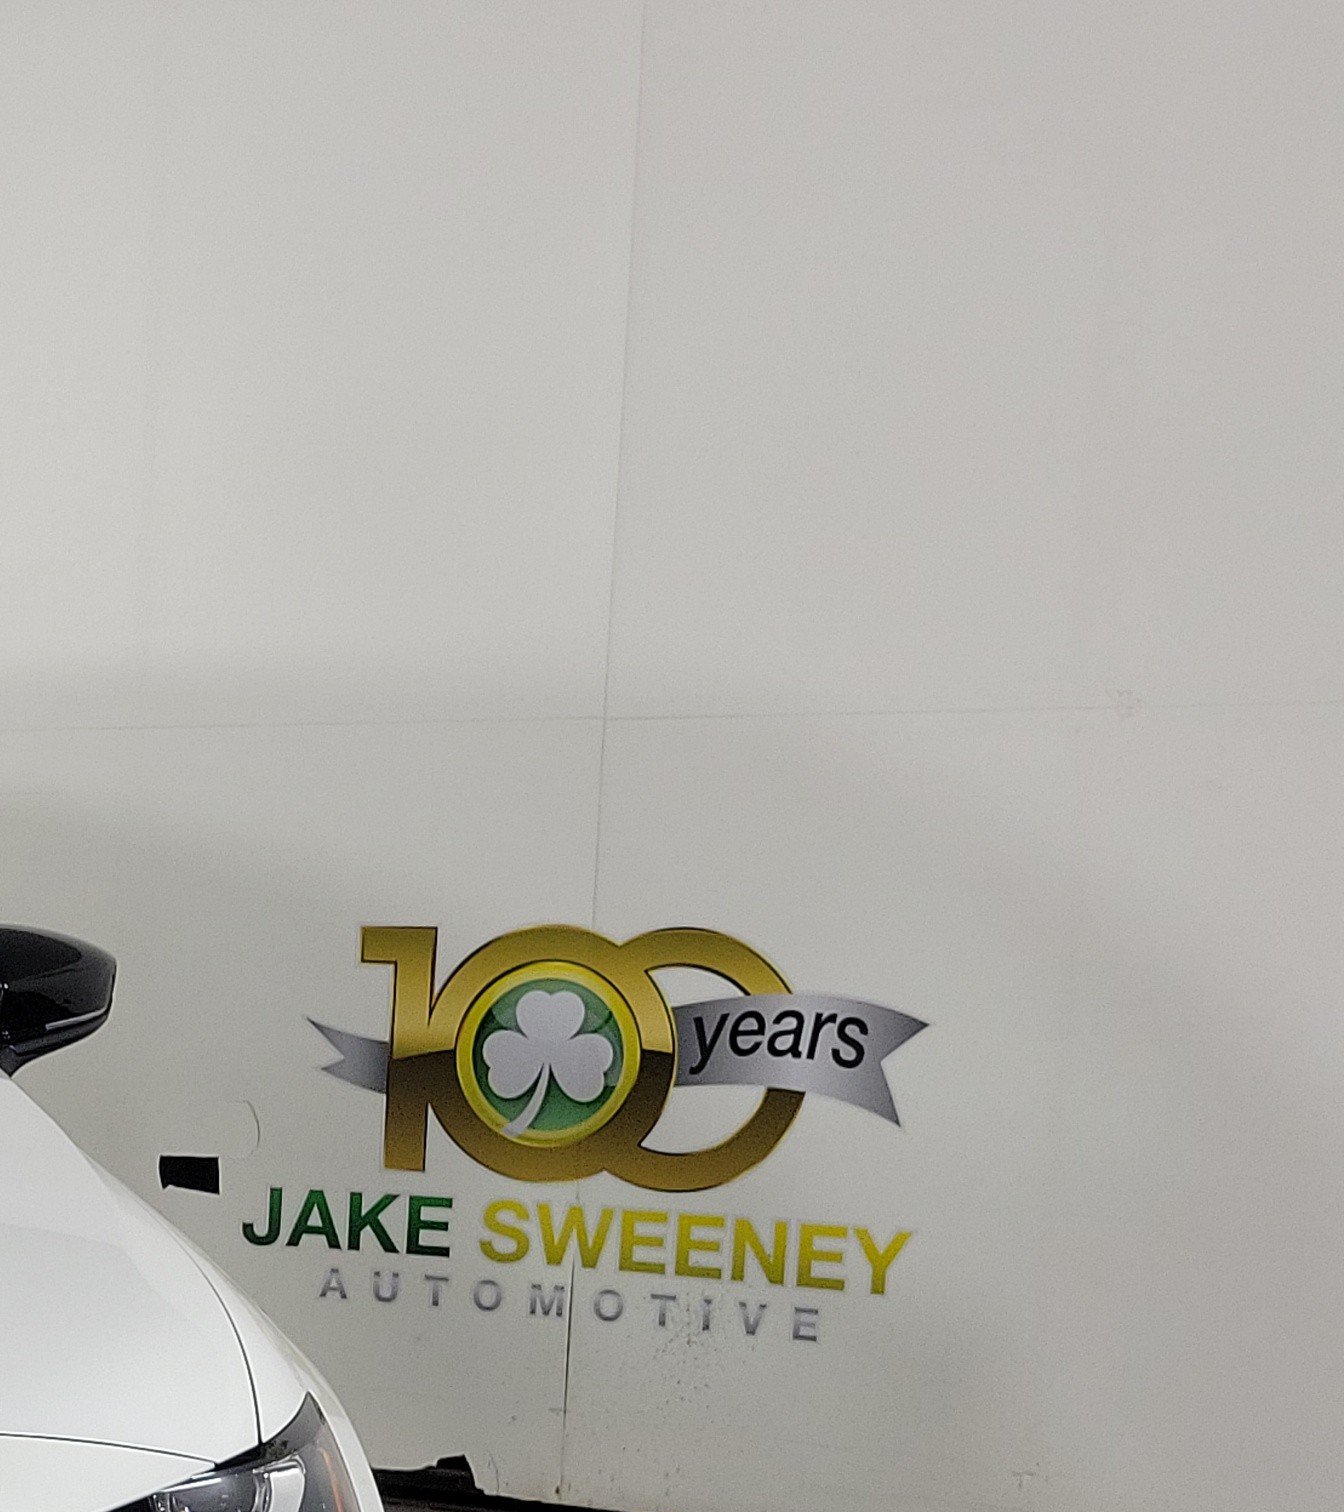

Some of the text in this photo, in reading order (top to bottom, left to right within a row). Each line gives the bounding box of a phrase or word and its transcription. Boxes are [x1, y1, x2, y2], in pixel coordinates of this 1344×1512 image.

[360, 924, 870, 1193] 100 years
[241, 1187, 912, 1296] JAKE SWEENEY
[319, 1268, 819, 1343] AUTOMOTIVE
